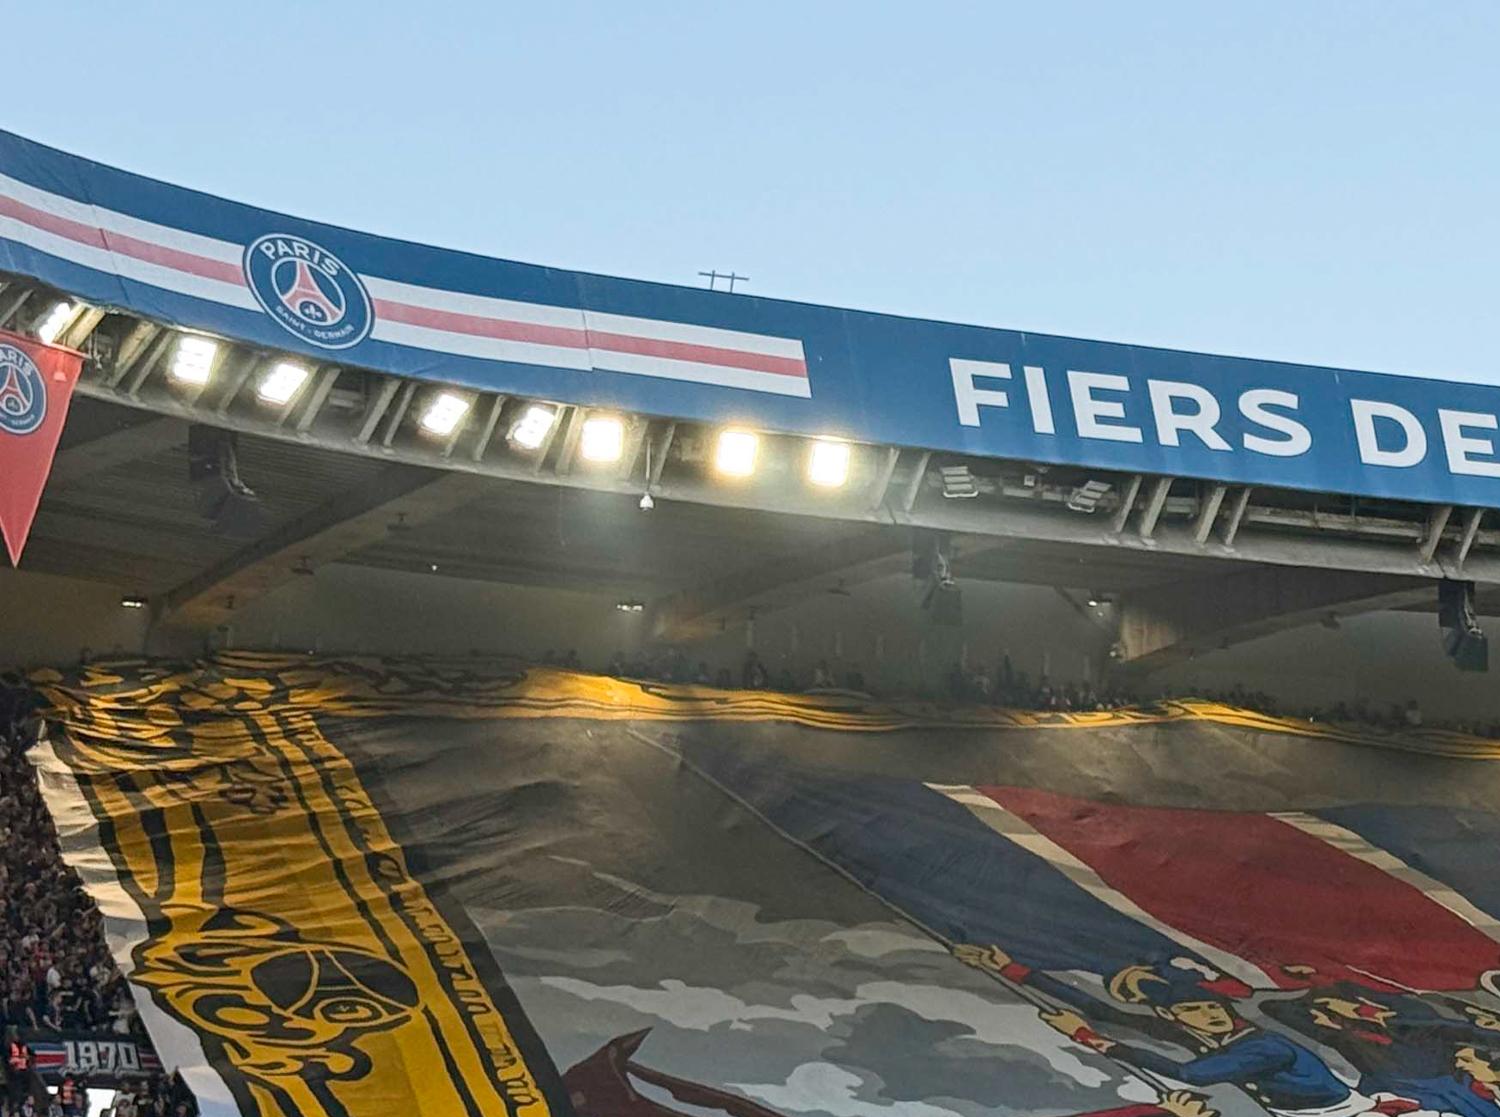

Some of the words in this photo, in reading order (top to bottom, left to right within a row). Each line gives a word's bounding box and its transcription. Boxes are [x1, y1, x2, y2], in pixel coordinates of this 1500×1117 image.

[259, 239, 341, 276] PARIS
[948, 357, 1313, 458] FIERS
[63, 1040, 140, 1071] 1970
